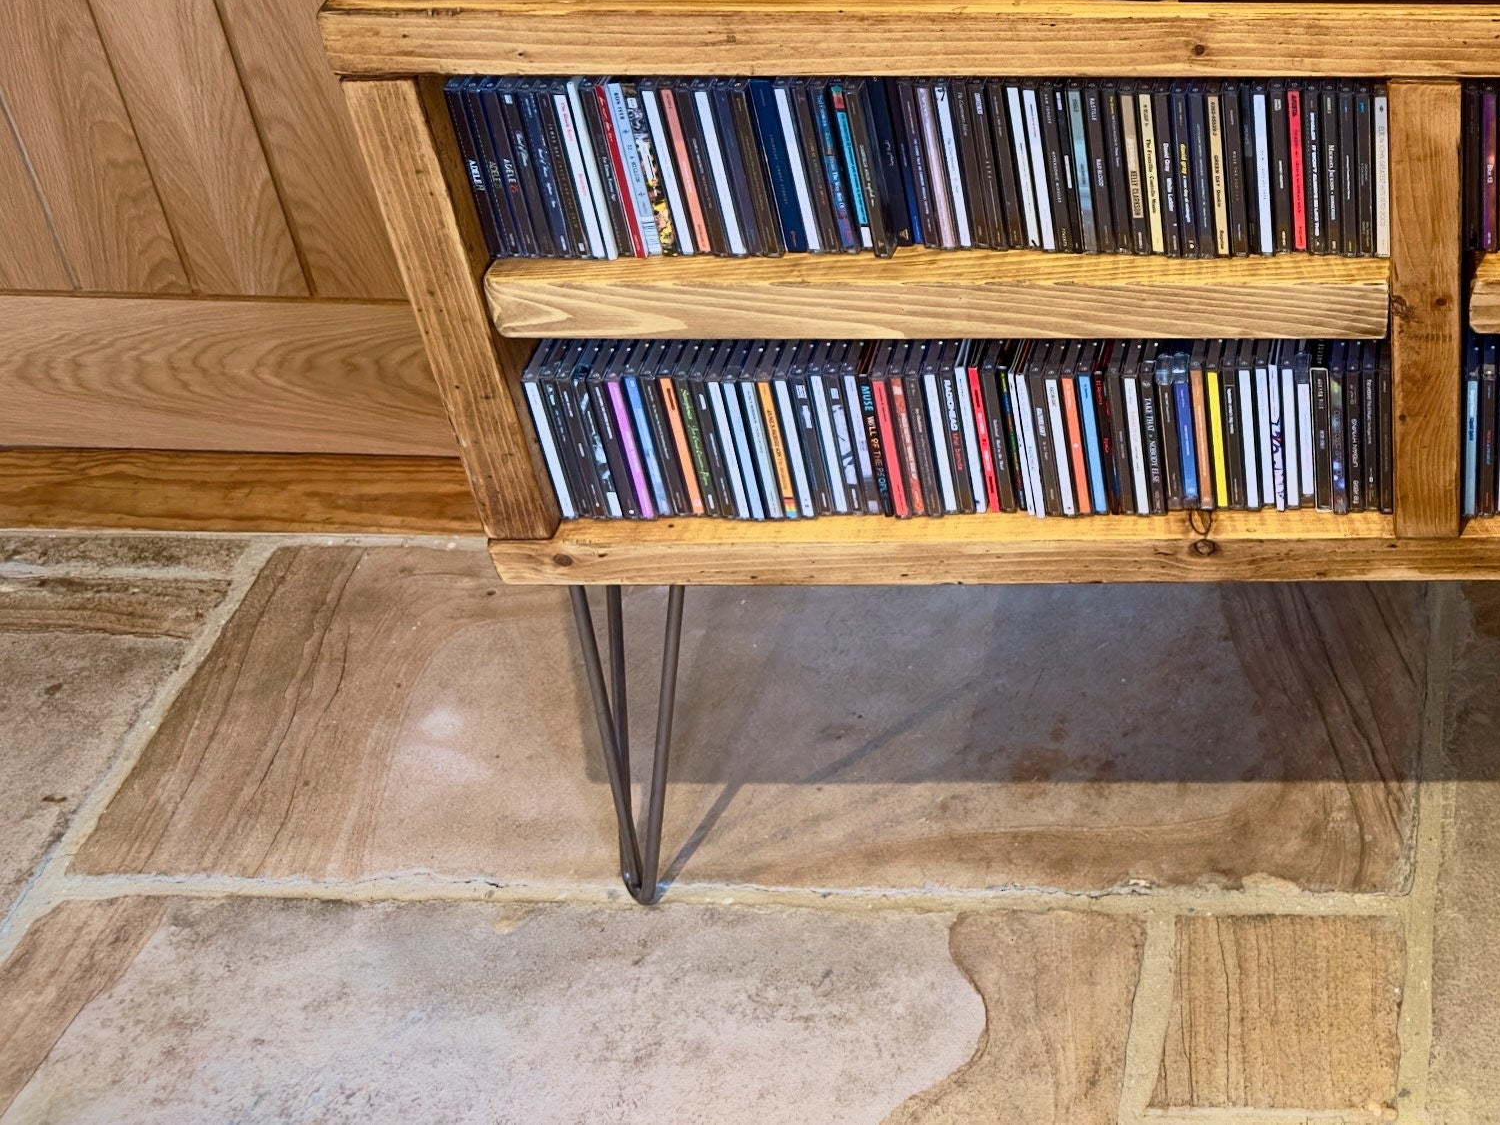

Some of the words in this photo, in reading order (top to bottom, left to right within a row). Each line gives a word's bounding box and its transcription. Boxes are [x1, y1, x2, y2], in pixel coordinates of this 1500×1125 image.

[468, 159, 481, 184] ADELE
[488, 161, 500, 182] ADELE
[502, 158, 516, 182] ADELE
[1129, 170, 1139, 186] KELLY
[1132, 188, 1142, 215] CLARKSON
[860, 385, 872, 410] MUSE
[866, 416, 876, 435] WILL
[943, 379, 958, 430] RADIOHEAD
[952, 433, 960, 445] the
[1144, 398, 1152, 414] TAKE
[1146, 416, 1154, 431] THAT
[1148, 440, 1157, 466] NOBODY
[1151, 467, 1159, 483] ELSE
